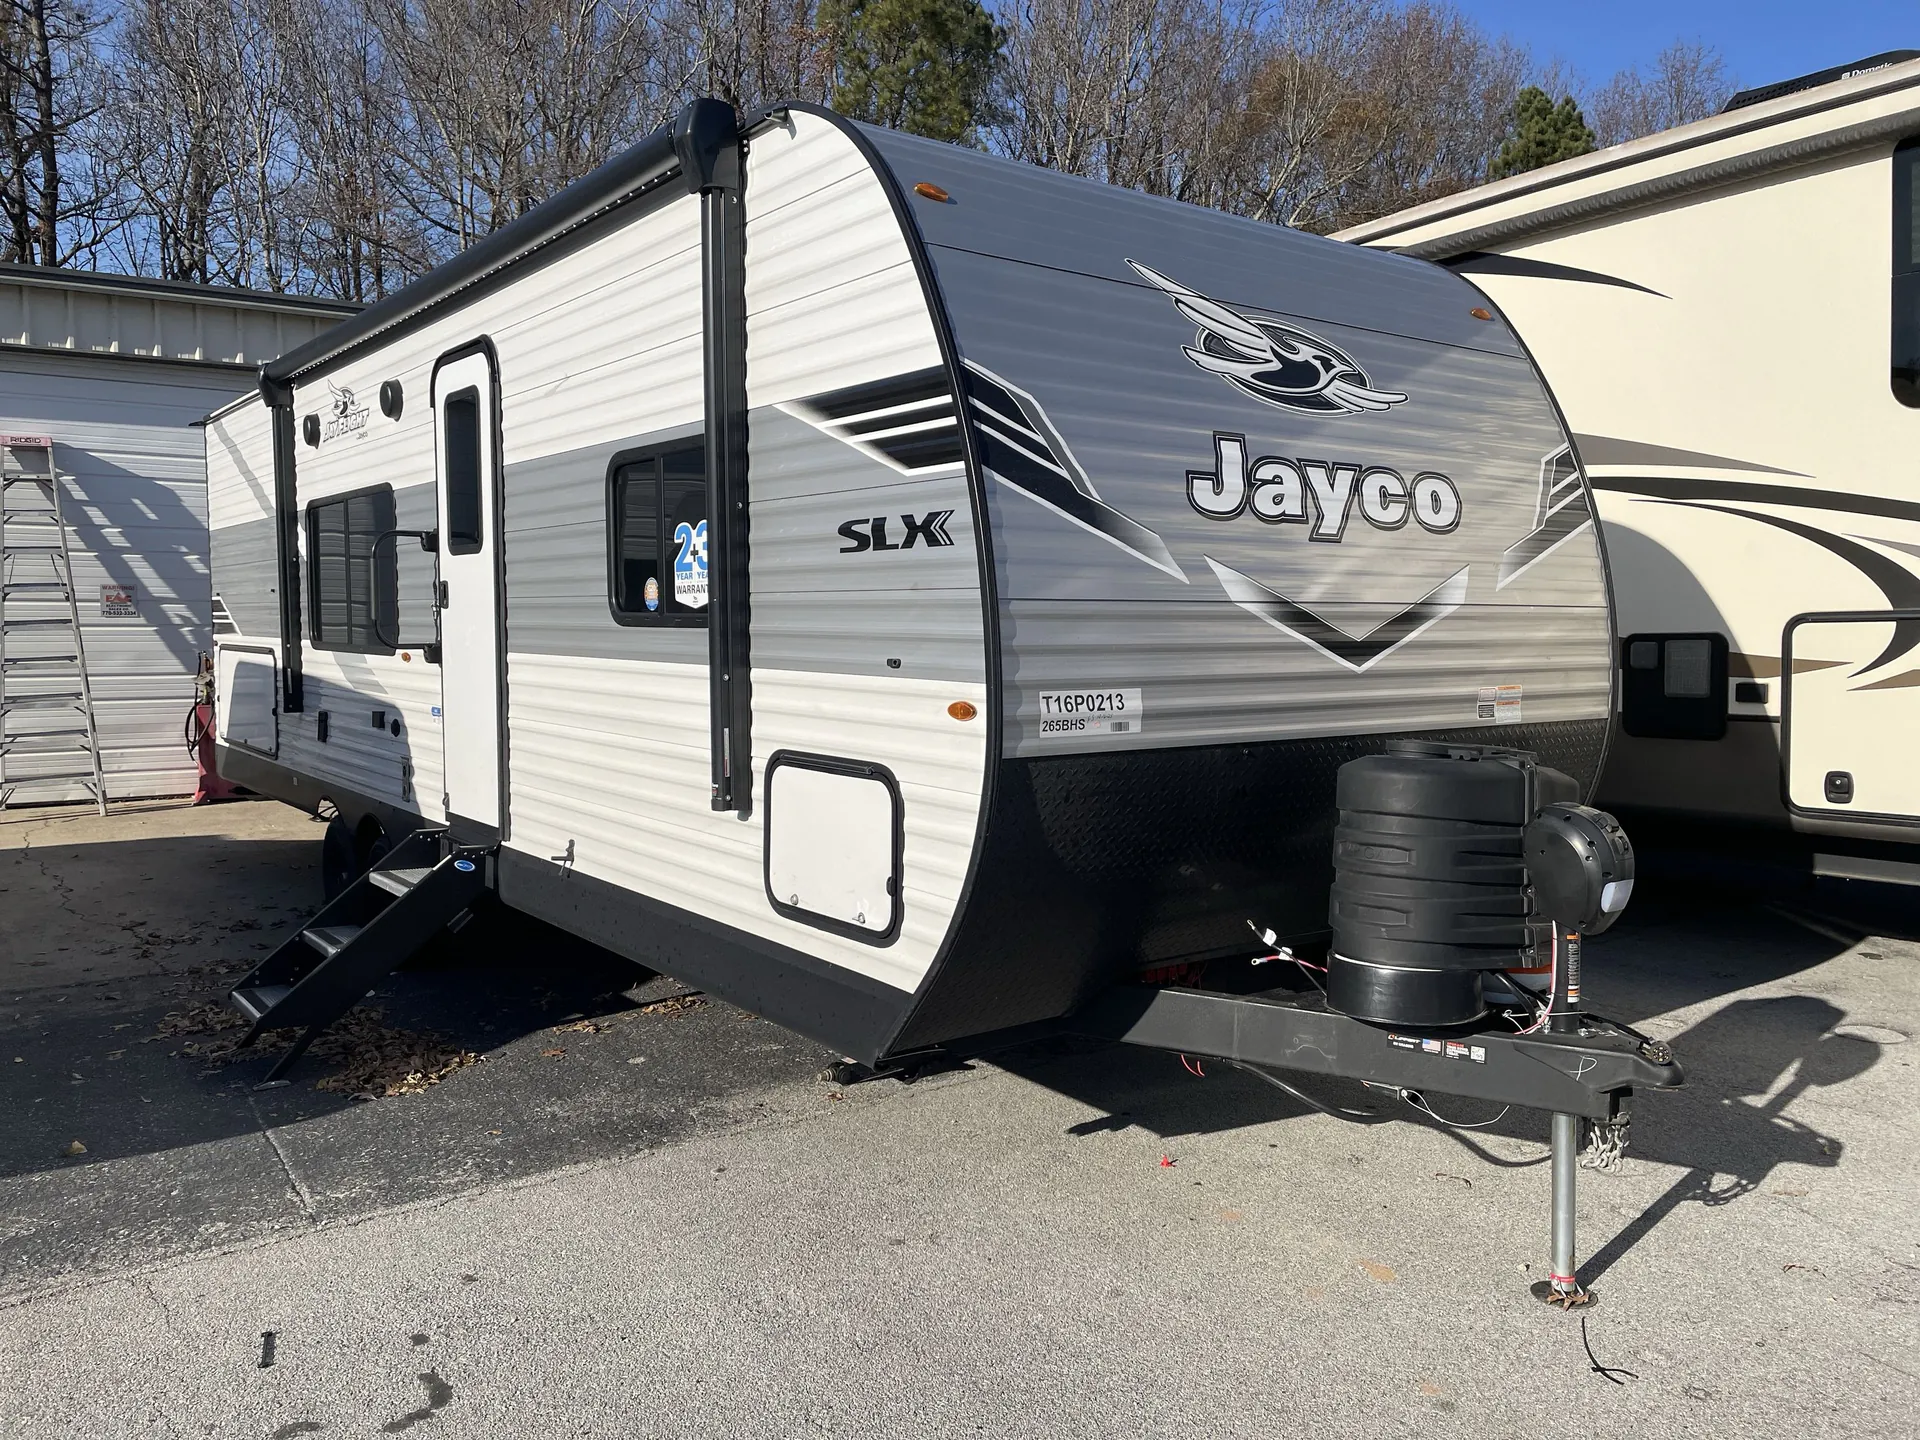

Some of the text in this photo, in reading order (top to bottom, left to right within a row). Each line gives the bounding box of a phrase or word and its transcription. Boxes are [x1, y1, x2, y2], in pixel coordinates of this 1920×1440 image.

[10, 436, 42, 444] RIDGID
[1185, 430, 1463, 543] Jayco
[838, 510, 955, 554] SLX
[697, 571, 708, 579] YEA
[1042, 693, 1125, 713] T16P0213
[1042, 718, 1085, 732] 265BHS
